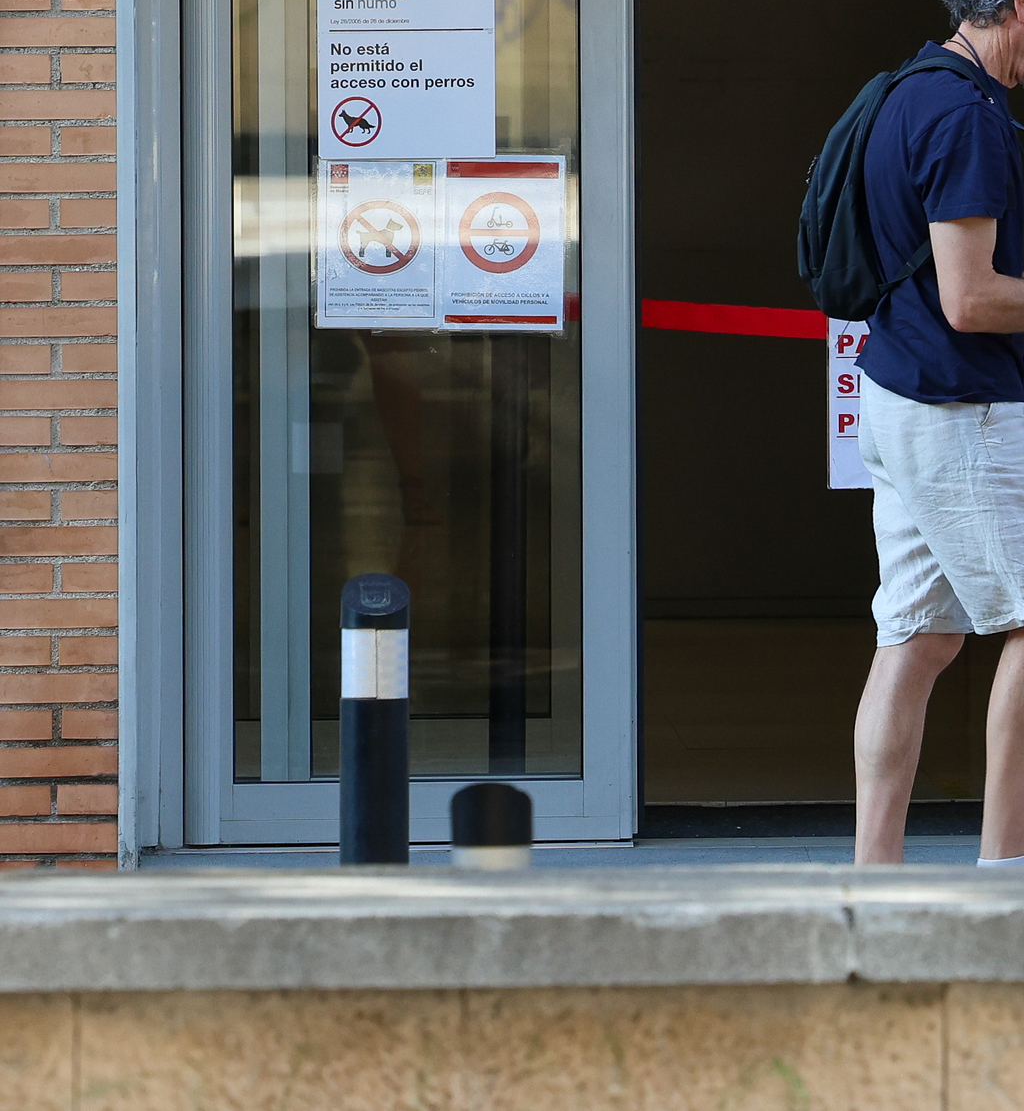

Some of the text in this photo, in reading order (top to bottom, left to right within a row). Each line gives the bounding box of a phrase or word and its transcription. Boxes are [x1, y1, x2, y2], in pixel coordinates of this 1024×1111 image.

[330, 42, 390, 56] No está
[330, 59, 423, 74] permitido el
[330, 77, 475, 90] acceso con perros
